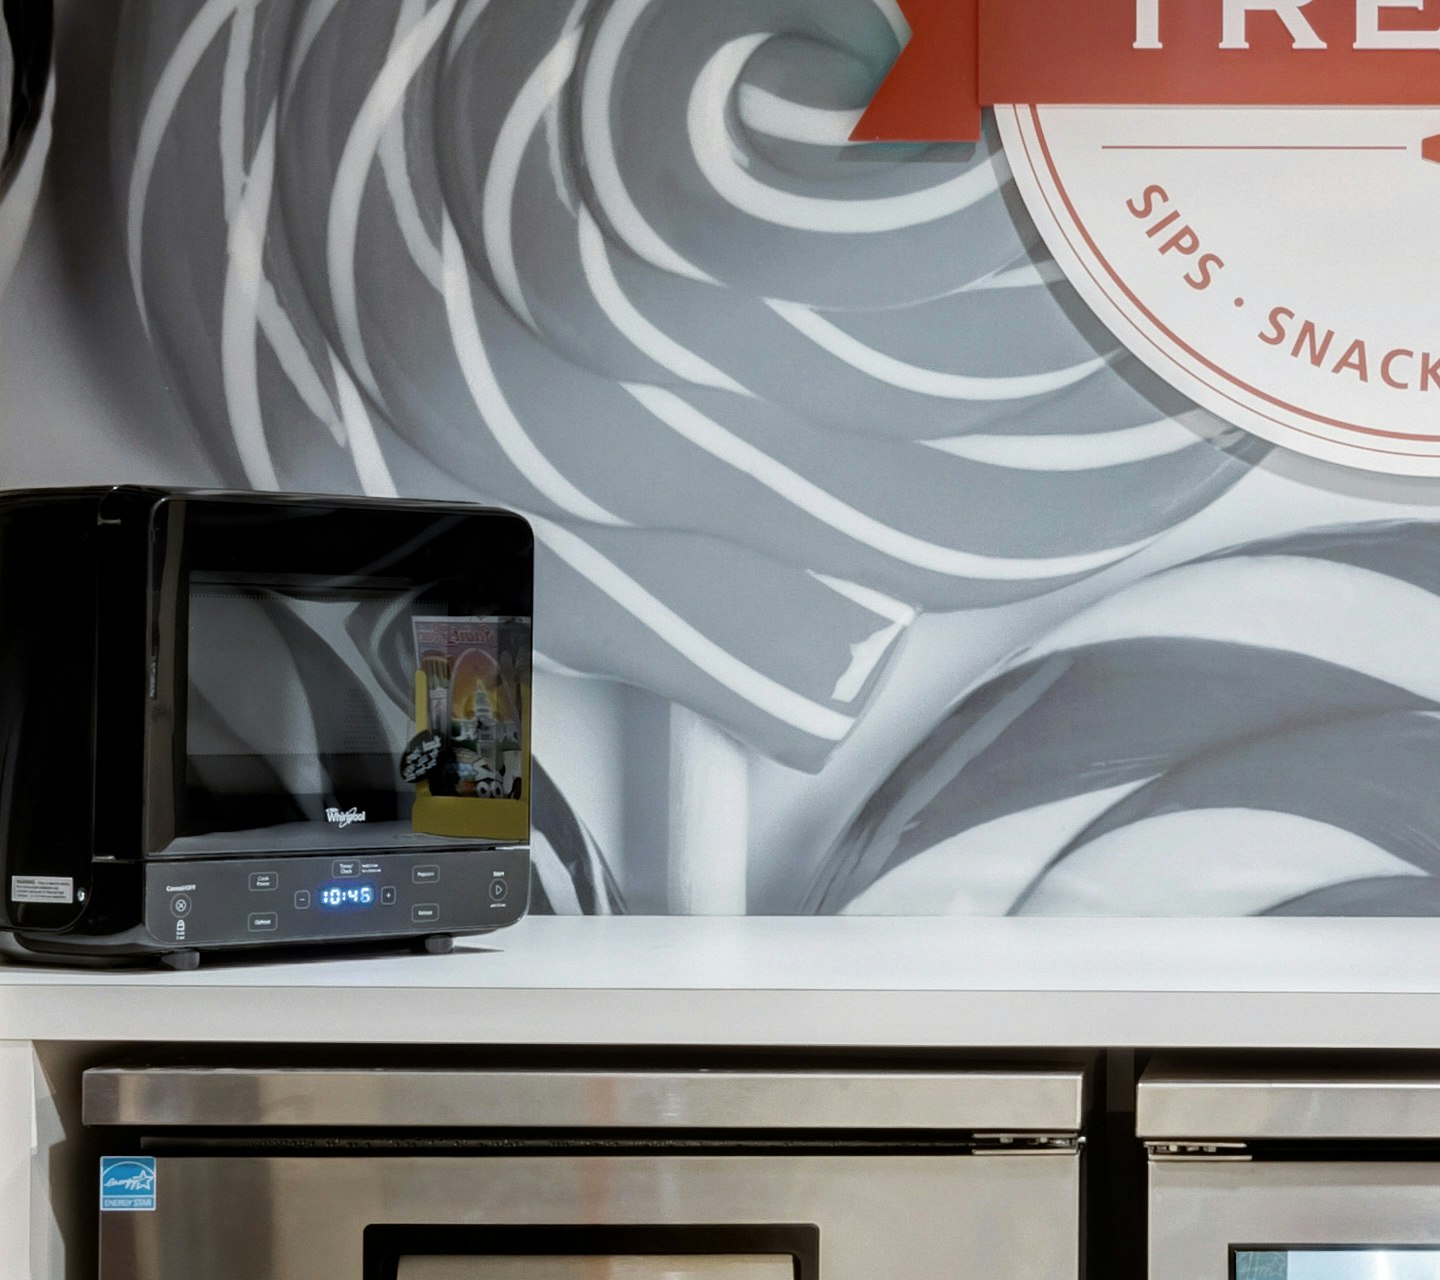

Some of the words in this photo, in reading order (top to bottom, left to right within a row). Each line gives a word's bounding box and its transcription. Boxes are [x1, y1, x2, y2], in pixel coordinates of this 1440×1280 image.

[1126, 183, 1226, 293] SIPS
[326, 807, 366, 828] Whirlpool
[323, 887, 372, 907] 10:46
[104, 1199, 132, 1207] ENERGY
[133, 1198, 152, 1207] STAR
